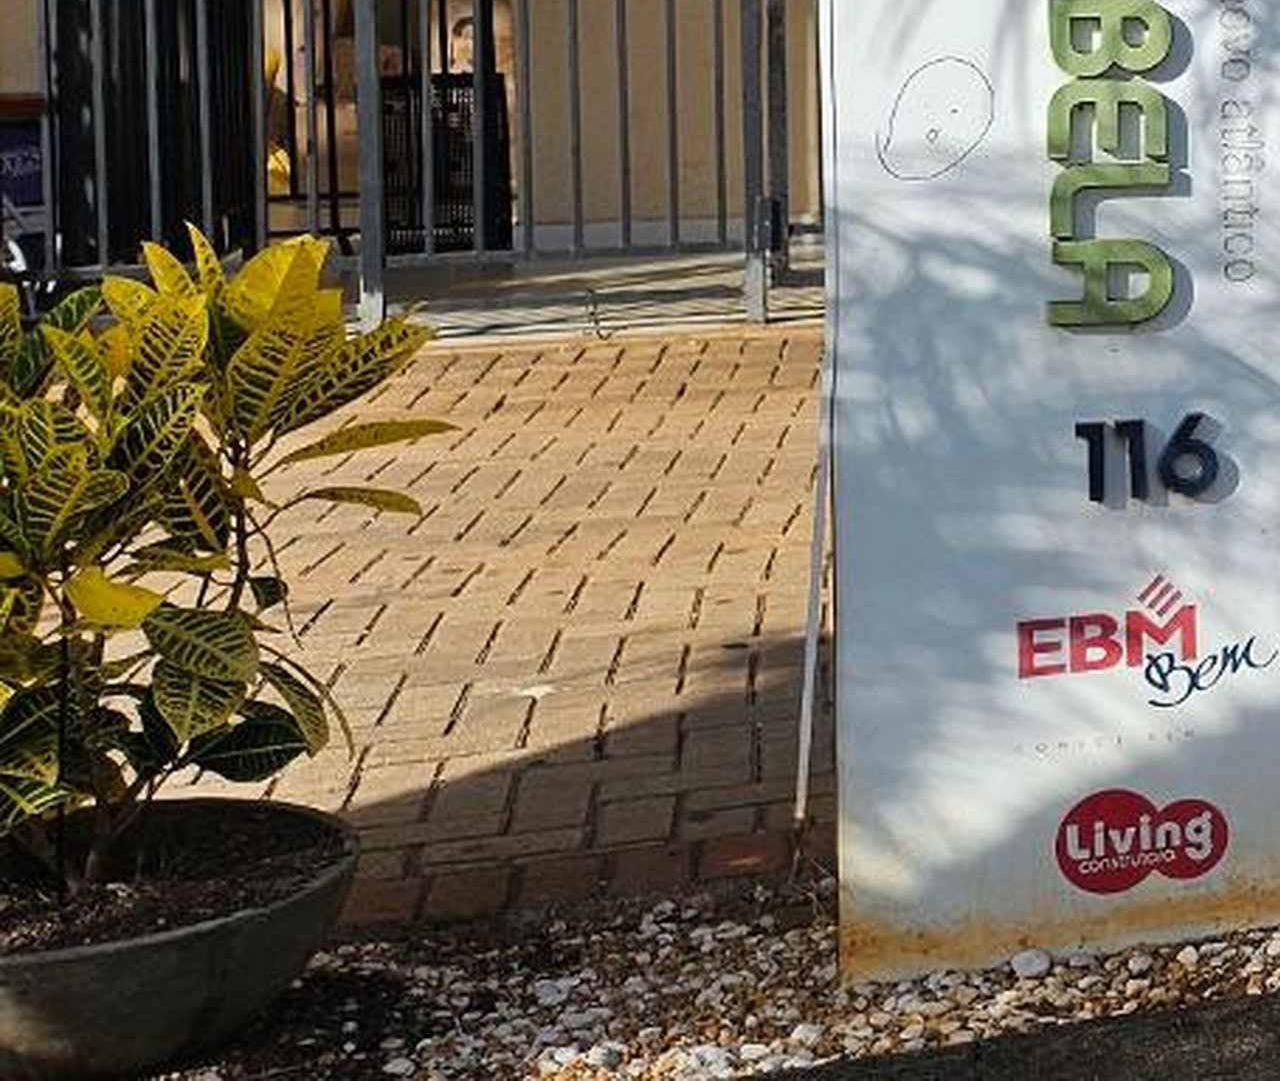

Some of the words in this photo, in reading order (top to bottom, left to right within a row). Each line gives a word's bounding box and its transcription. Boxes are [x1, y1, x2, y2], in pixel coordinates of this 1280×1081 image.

[1075, 412, 1220, 503] 116
[1018, 604, 1197, 679] EBM
[1144, 635, 1279, 708] Bem
[1066, 811, 1213, 861] Living
